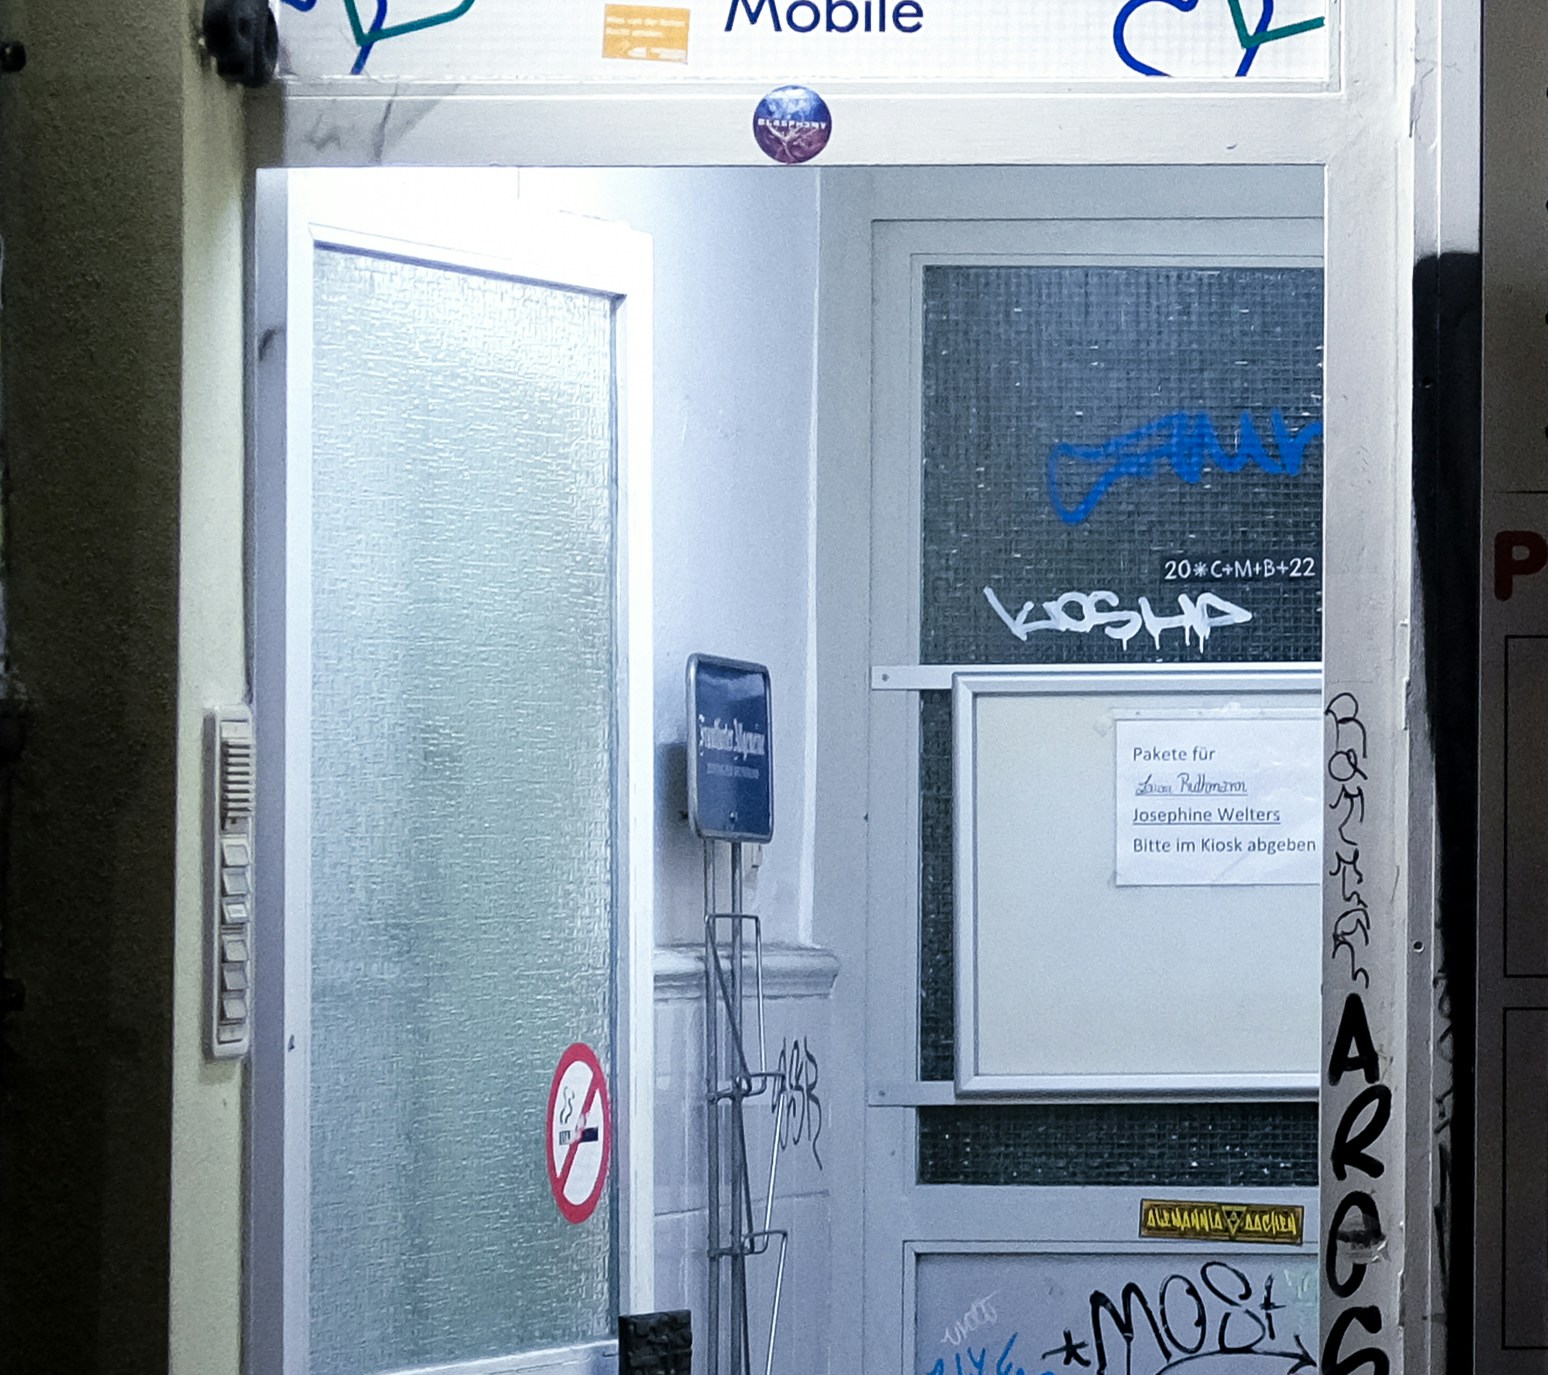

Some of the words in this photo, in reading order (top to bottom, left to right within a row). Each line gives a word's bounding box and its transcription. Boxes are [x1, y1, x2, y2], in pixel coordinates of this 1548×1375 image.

[1133, 746, 1187, 762] Pakete
[1192, 746, 1216, 762] für
[1132, 806, 1212, 823] Josephine
[1216, 807, 1281, 822] Welters
[1133, 837, 1171, 853] Bitte
[1176, 837, 1196, 853] im
[1201, 837, 1243, 853] Kiosk
[1247, 836, 1316, 855] abgeben
